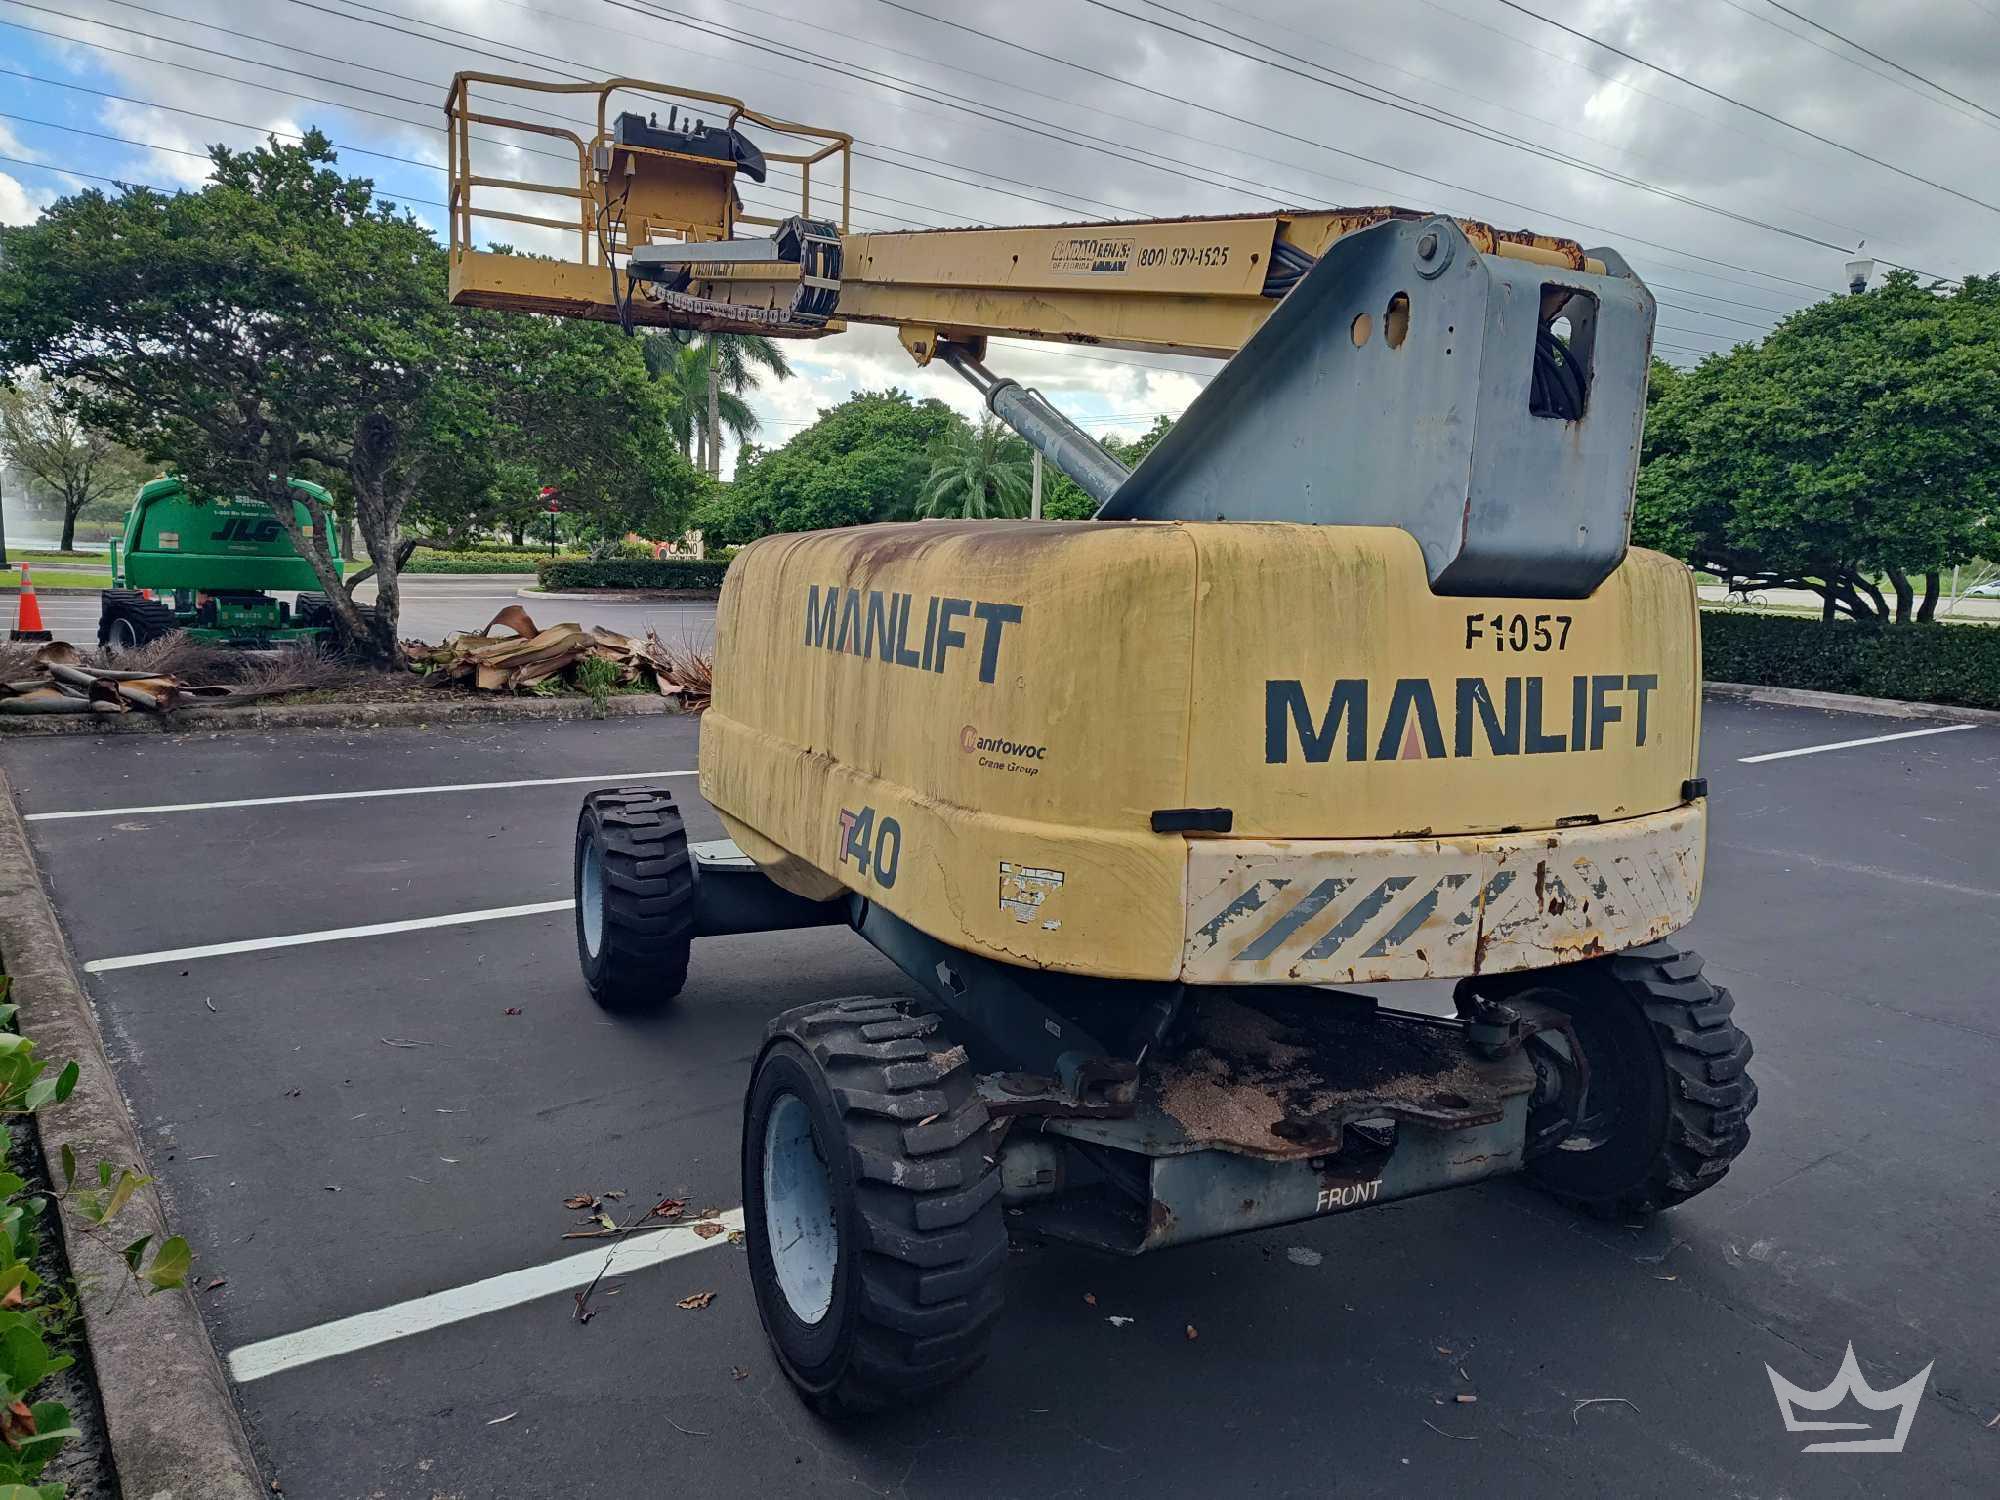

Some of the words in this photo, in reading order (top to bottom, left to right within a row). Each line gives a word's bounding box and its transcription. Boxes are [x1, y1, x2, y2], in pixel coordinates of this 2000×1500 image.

[1063, 261, 1090, 270] FLORIDA
[1137, 247, 1168, 267] (800)
[210, 519, 288, 542] JLG
[804, 584, 1023, 685] MANLIFT
[1465, 613, 1573, 652] F1057
[1265, 674, 1658, 764] MANLIFT
[978, 756, 1005, 770] Crane
[1007, 762, 1039, 777] Group
[839, 805, 900, 889] T40
[1315, 1180, 1383, 1212] FRONT
